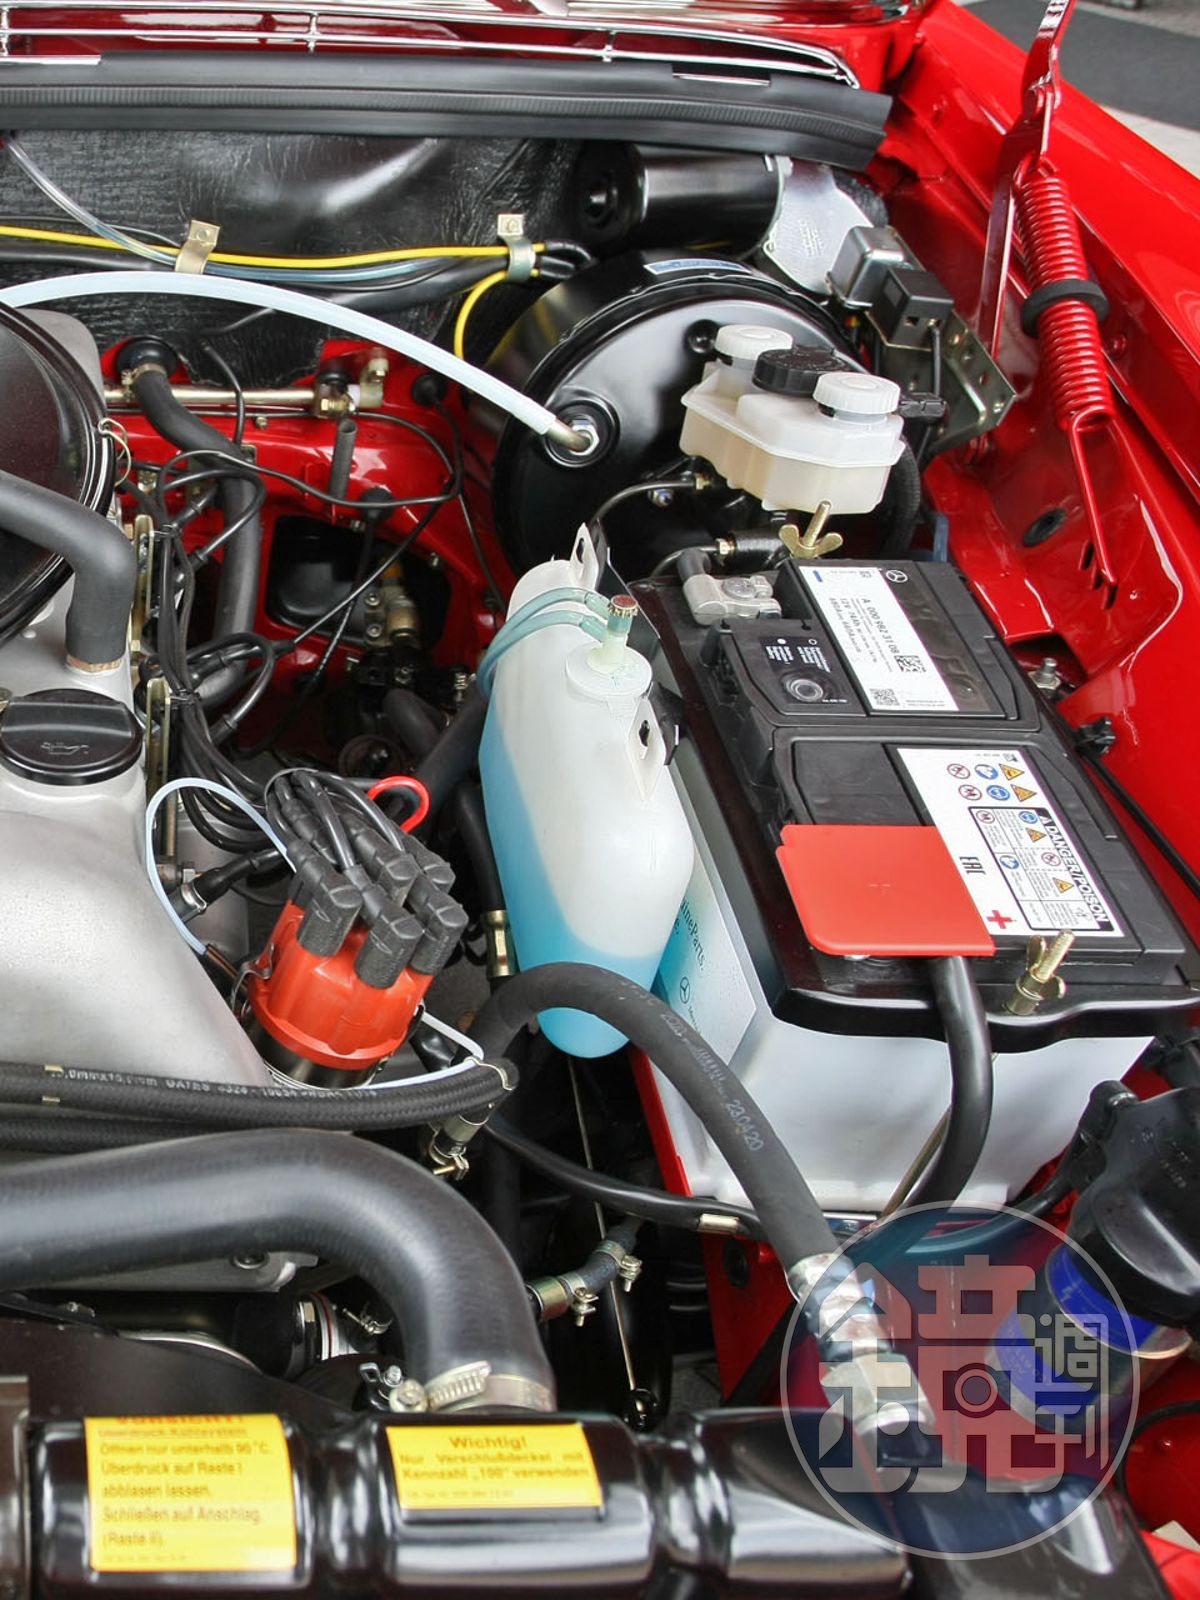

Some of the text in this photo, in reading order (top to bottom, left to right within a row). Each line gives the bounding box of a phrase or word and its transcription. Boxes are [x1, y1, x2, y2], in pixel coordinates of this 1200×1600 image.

[450, 1436, 527, 1451] Wichtig!
[400, 1454, 425, 1464] Nur
[562, 1452, 585, 1463] mit
[174, 1461, 194, 1474] auf
[402, 1468, 468, 1480] Kennzahl
[172, 1507, 194, 1521] auf
